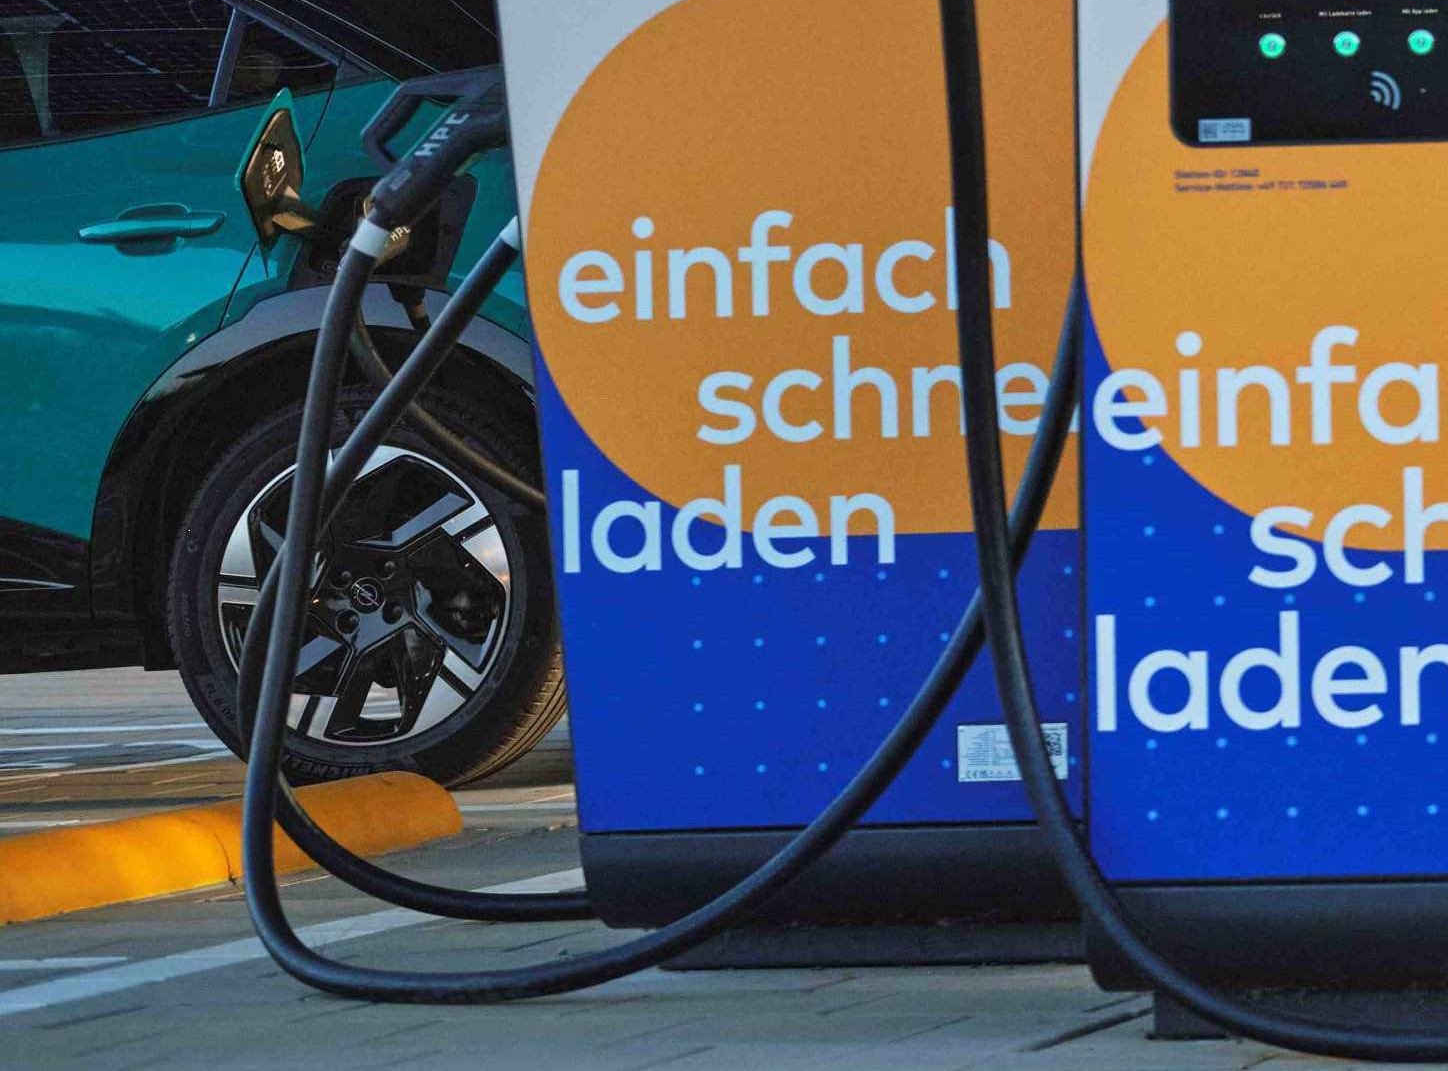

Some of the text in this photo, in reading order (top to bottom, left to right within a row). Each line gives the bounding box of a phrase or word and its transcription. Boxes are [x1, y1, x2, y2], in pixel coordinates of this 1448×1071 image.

[414, 110, 470, 158] HPC
[558, 208, 1011, 324] einfach
[697, 335, 1080, 445] schne
[562, 465, 895, 574] laden
